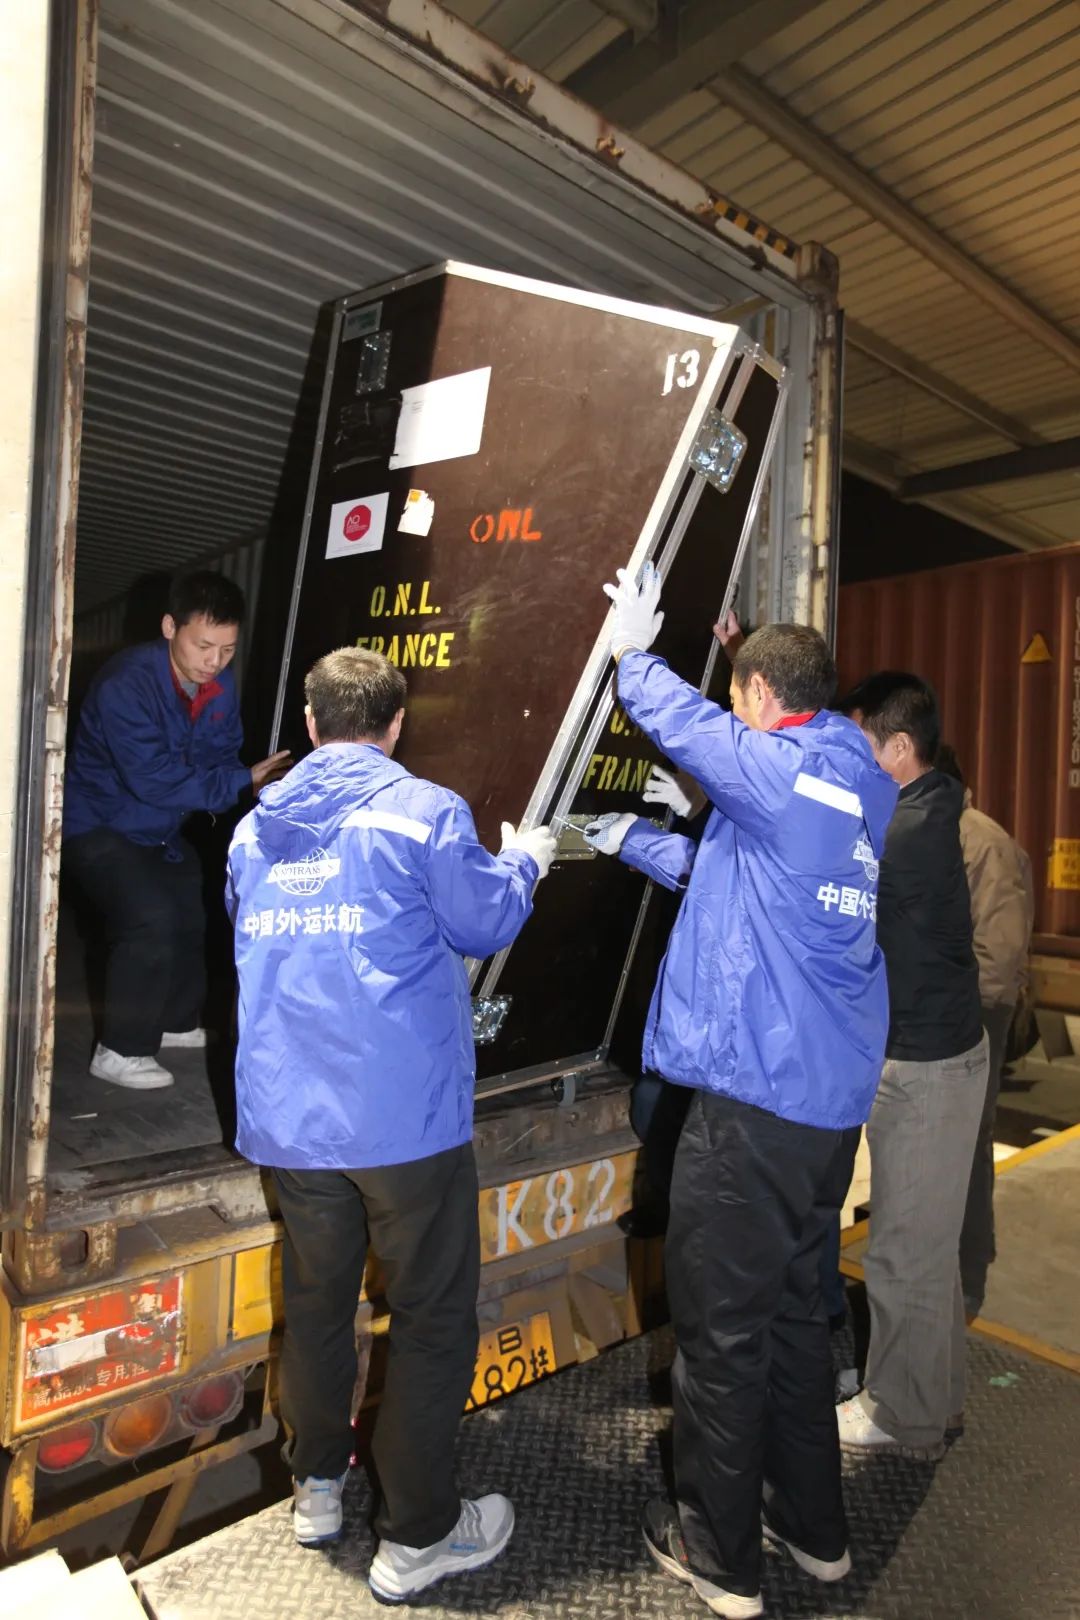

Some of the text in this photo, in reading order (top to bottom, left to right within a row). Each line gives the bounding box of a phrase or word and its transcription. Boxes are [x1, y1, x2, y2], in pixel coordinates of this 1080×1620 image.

[661, 349, 700, 396] 13
[470, 508, 542, 543] ONL
[370, 581, 441, 617] O.N.L.
[582, 754, 654, 792] FRAN
[244, 903, 365, 942] 中国外运长航
[496, 1159, 615, 1257] K82
